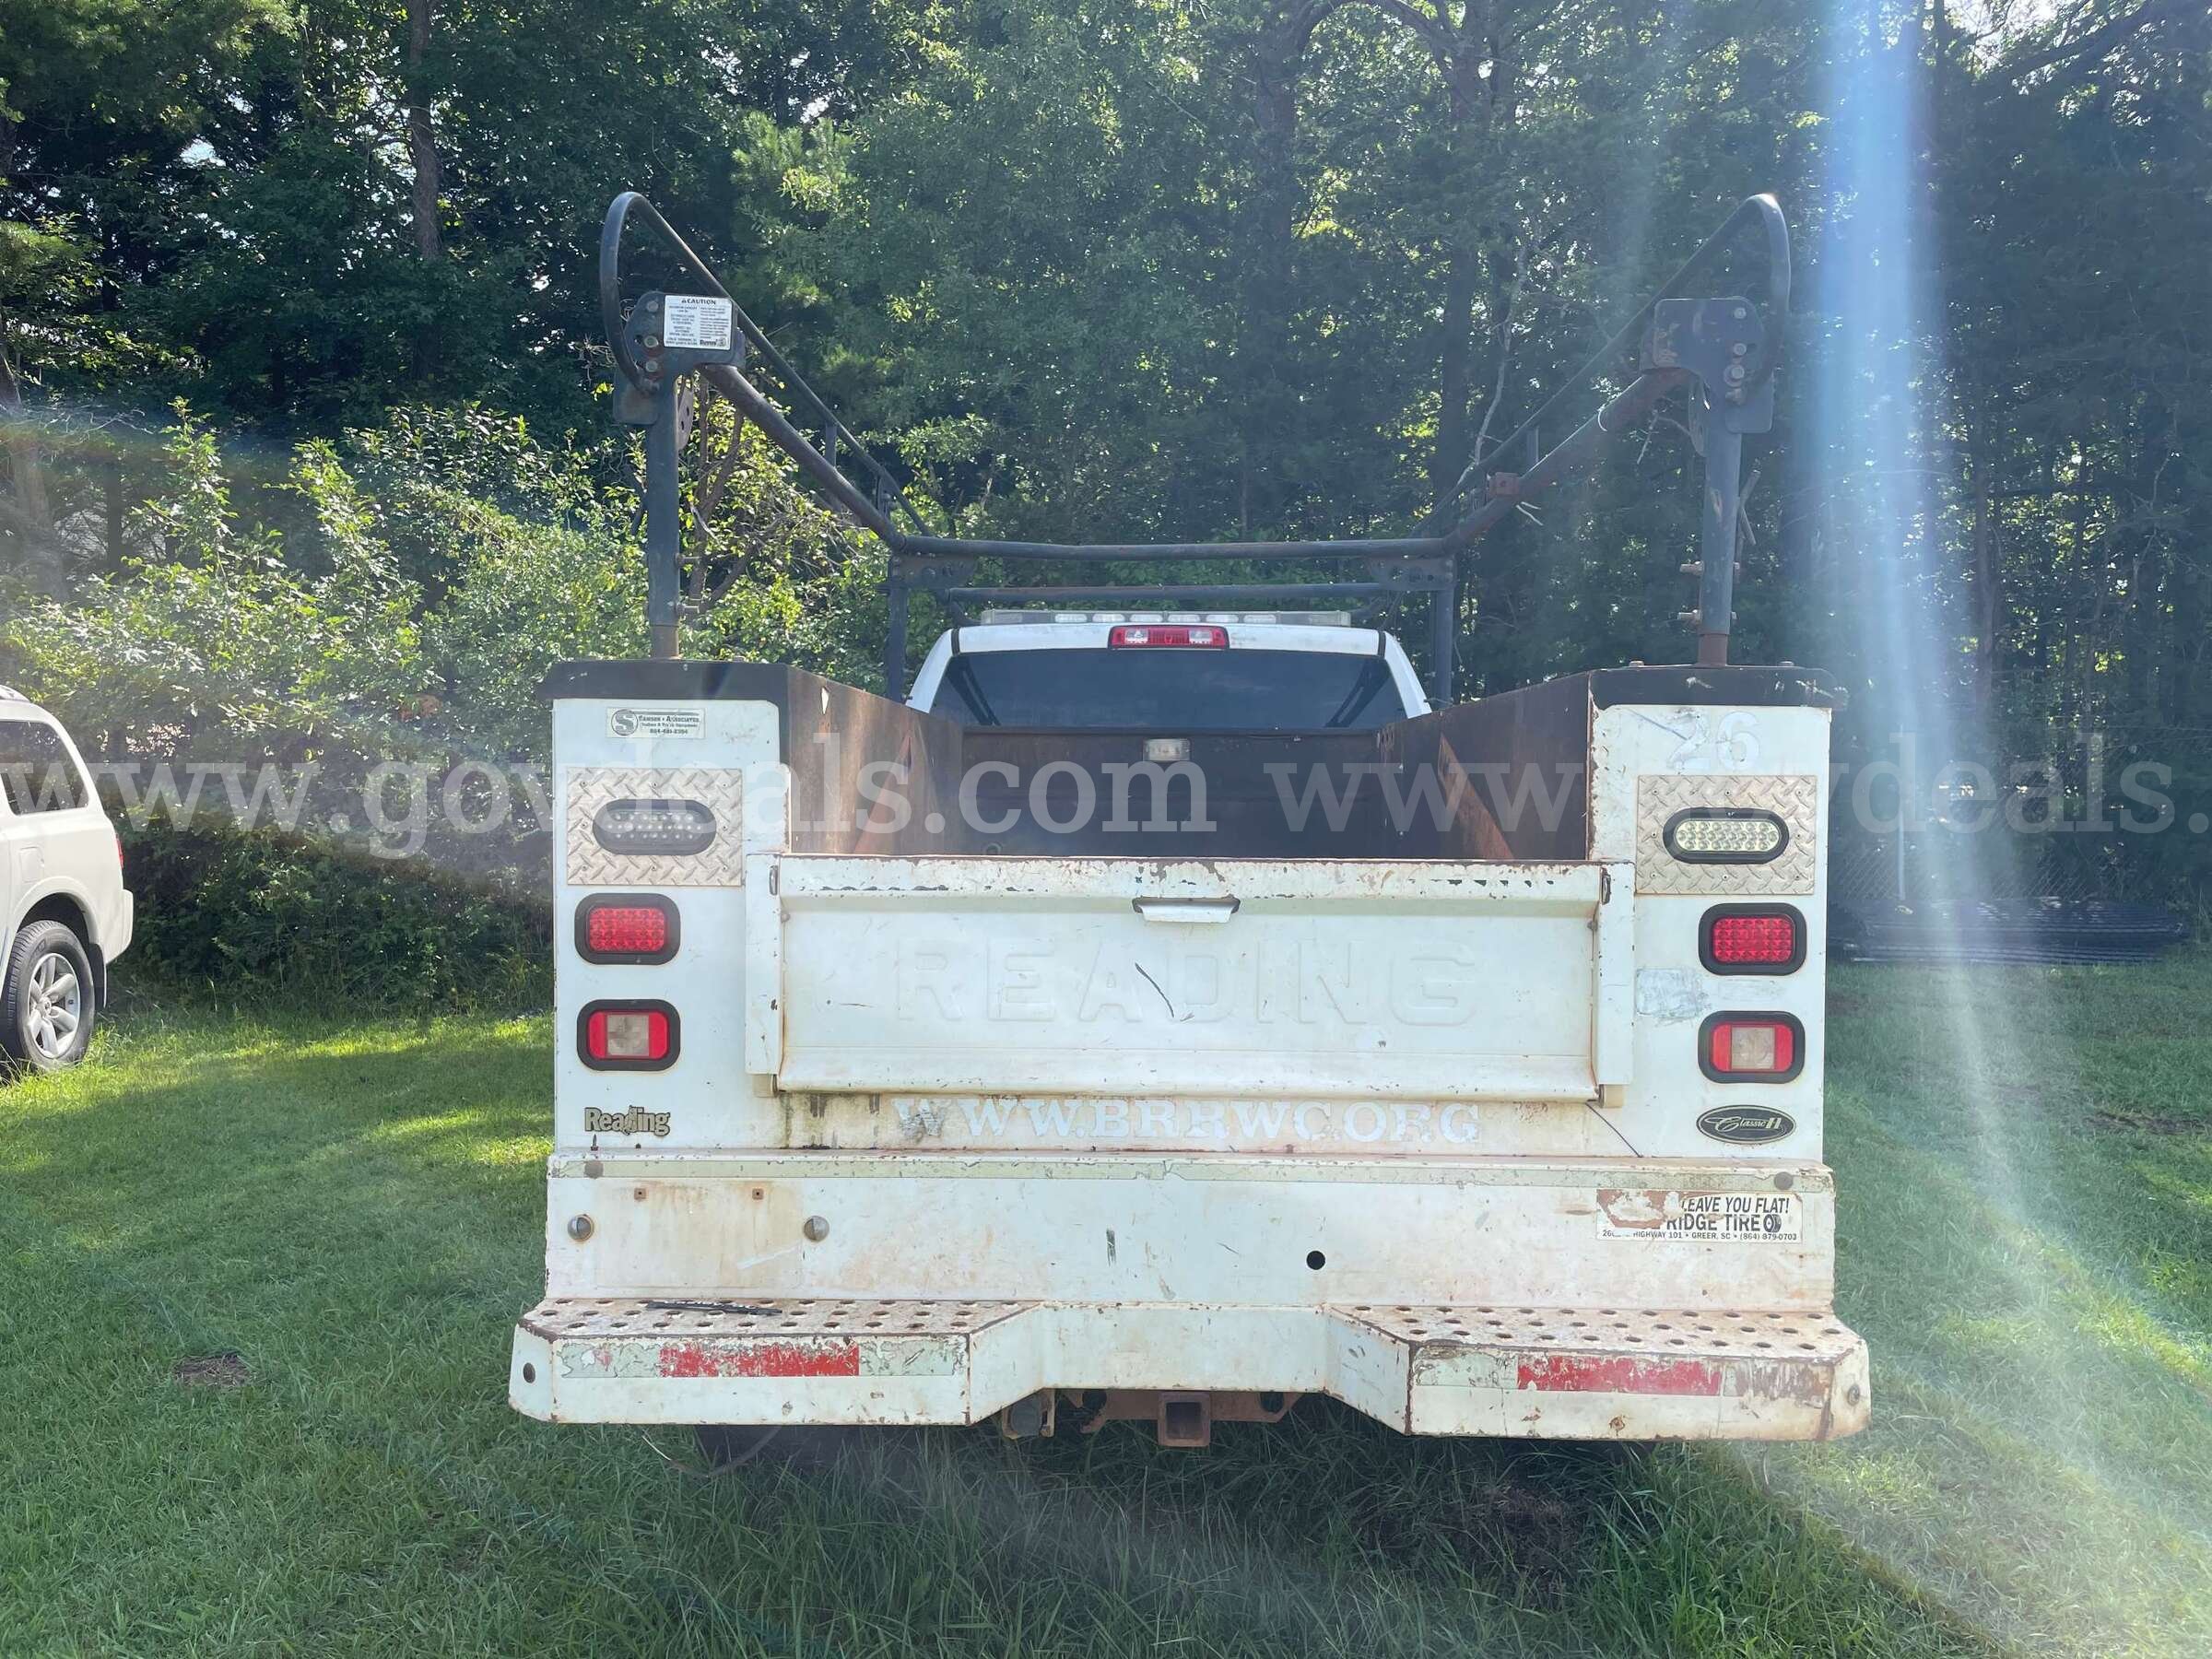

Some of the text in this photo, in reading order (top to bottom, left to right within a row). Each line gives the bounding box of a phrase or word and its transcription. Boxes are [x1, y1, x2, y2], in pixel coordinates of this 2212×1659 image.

[894, 936, 1477, 1027] READING
[584, 1105, 671, 1137] Reading
[1725, 1196, 1752, 1213] YOU
[1755, 1196, 1790, 1214] FLAT!
[1666, 1212, 1761, 1231] RIDGE TIRE
[1739, 1232, 1760, 1241] (864)
